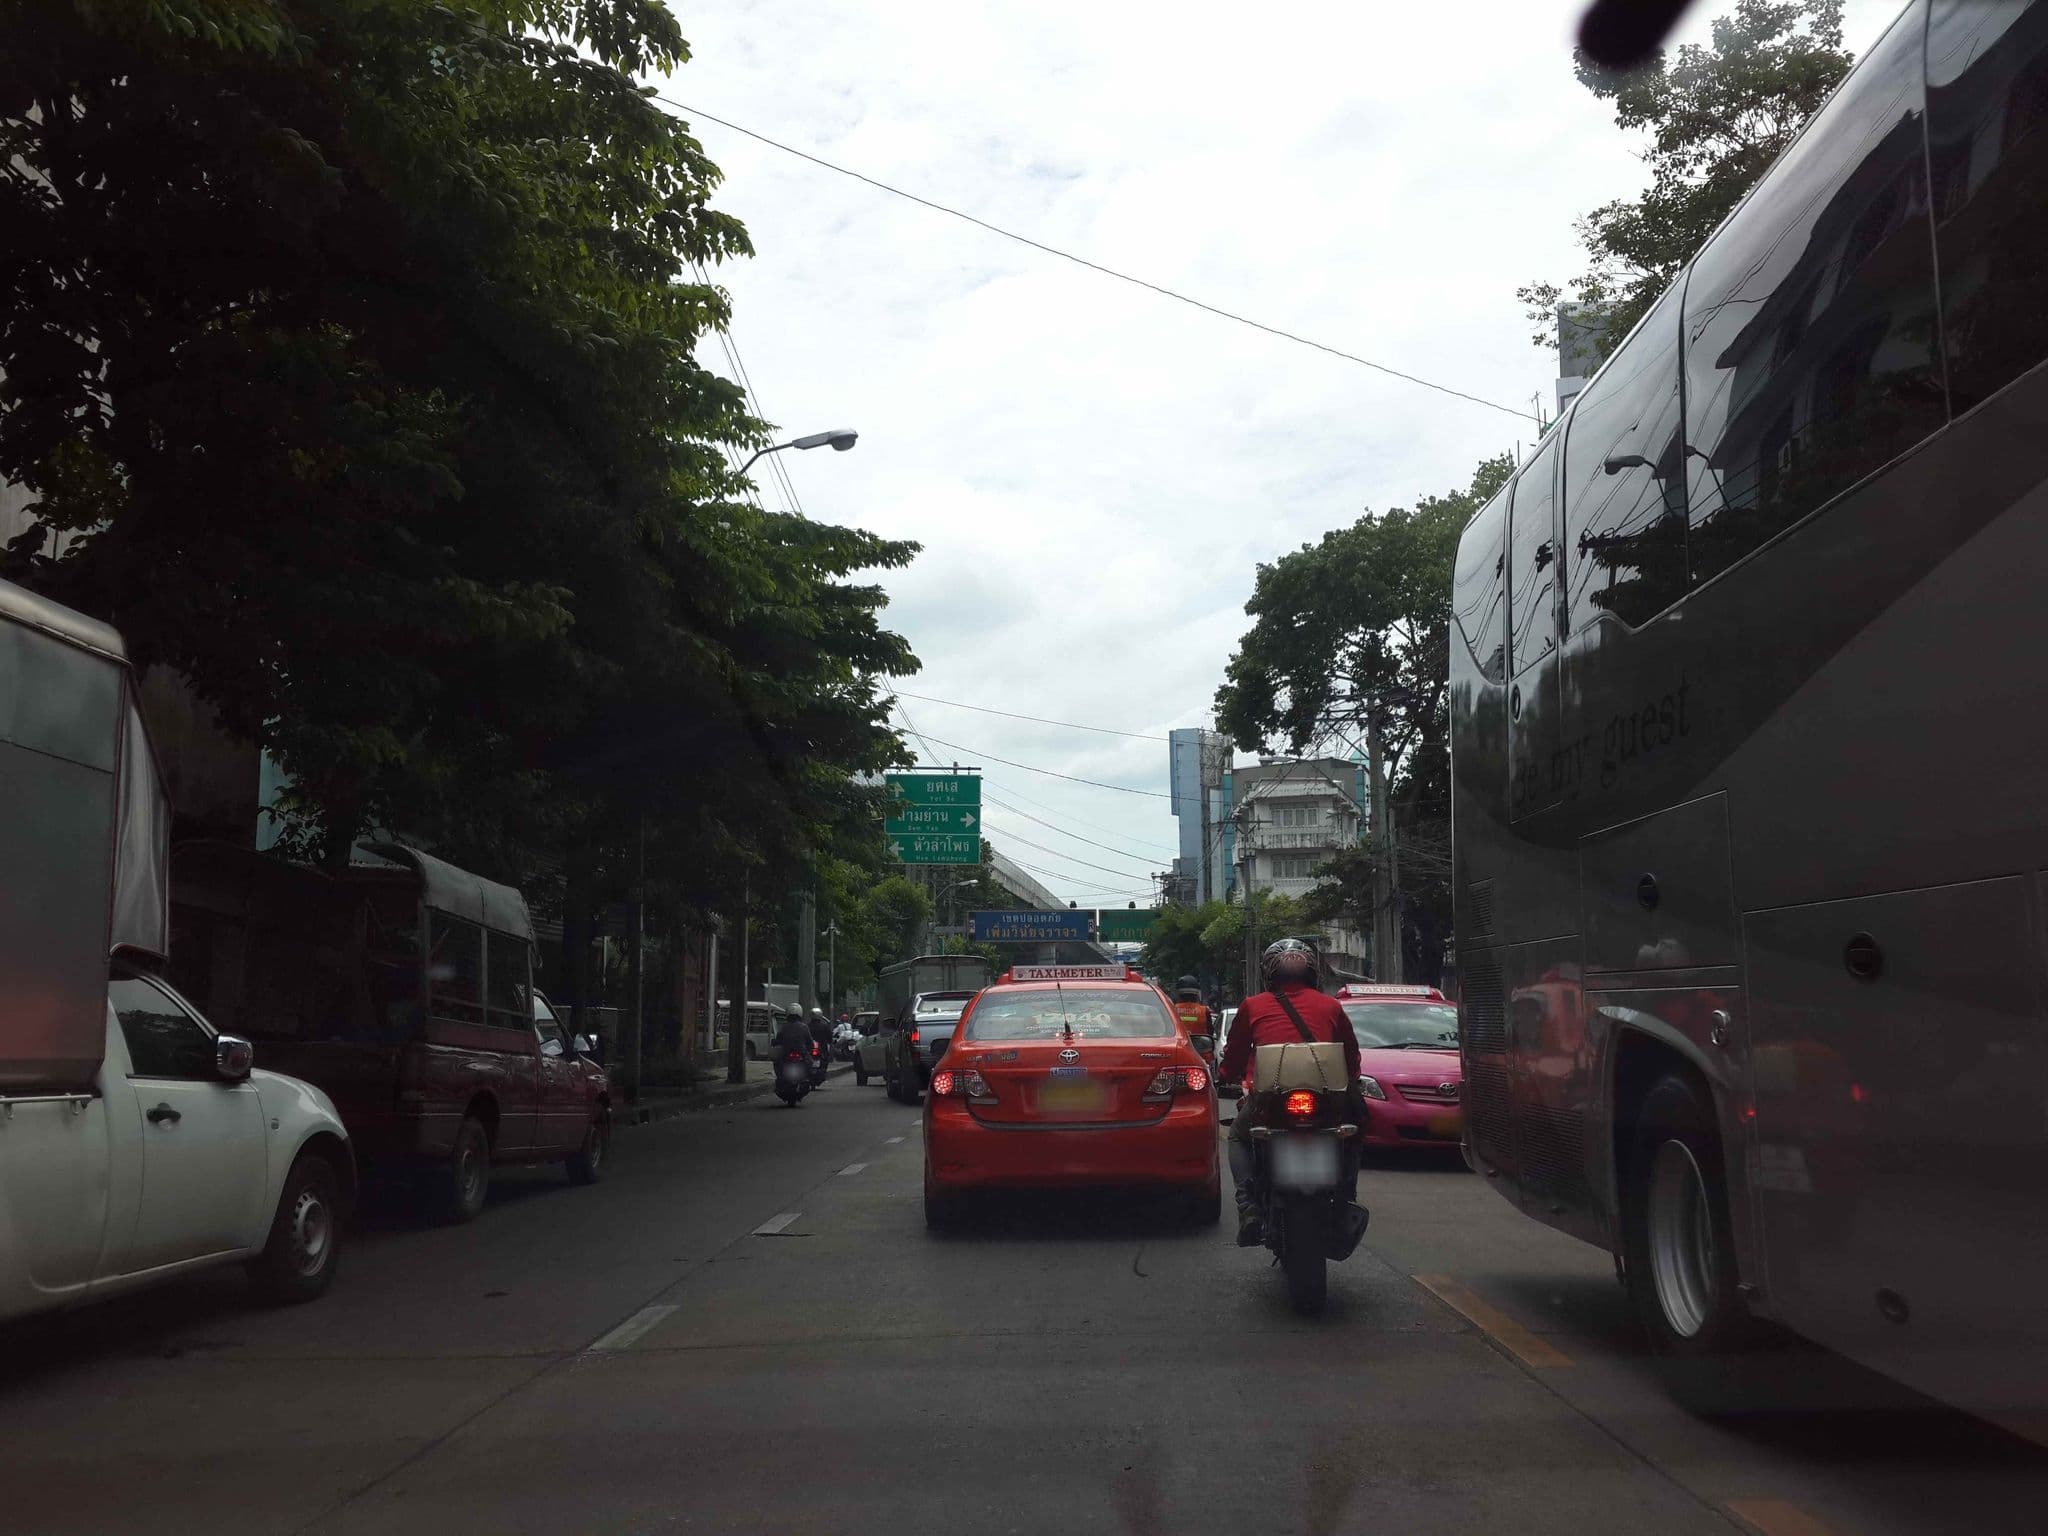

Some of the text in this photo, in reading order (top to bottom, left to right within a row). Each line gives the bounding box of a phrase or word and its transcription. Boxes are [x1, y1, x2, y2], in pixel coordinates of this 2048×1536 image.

[1599, 668, 1691, 791] guest
[914, 836, 970, 853] หัวลำโพง
